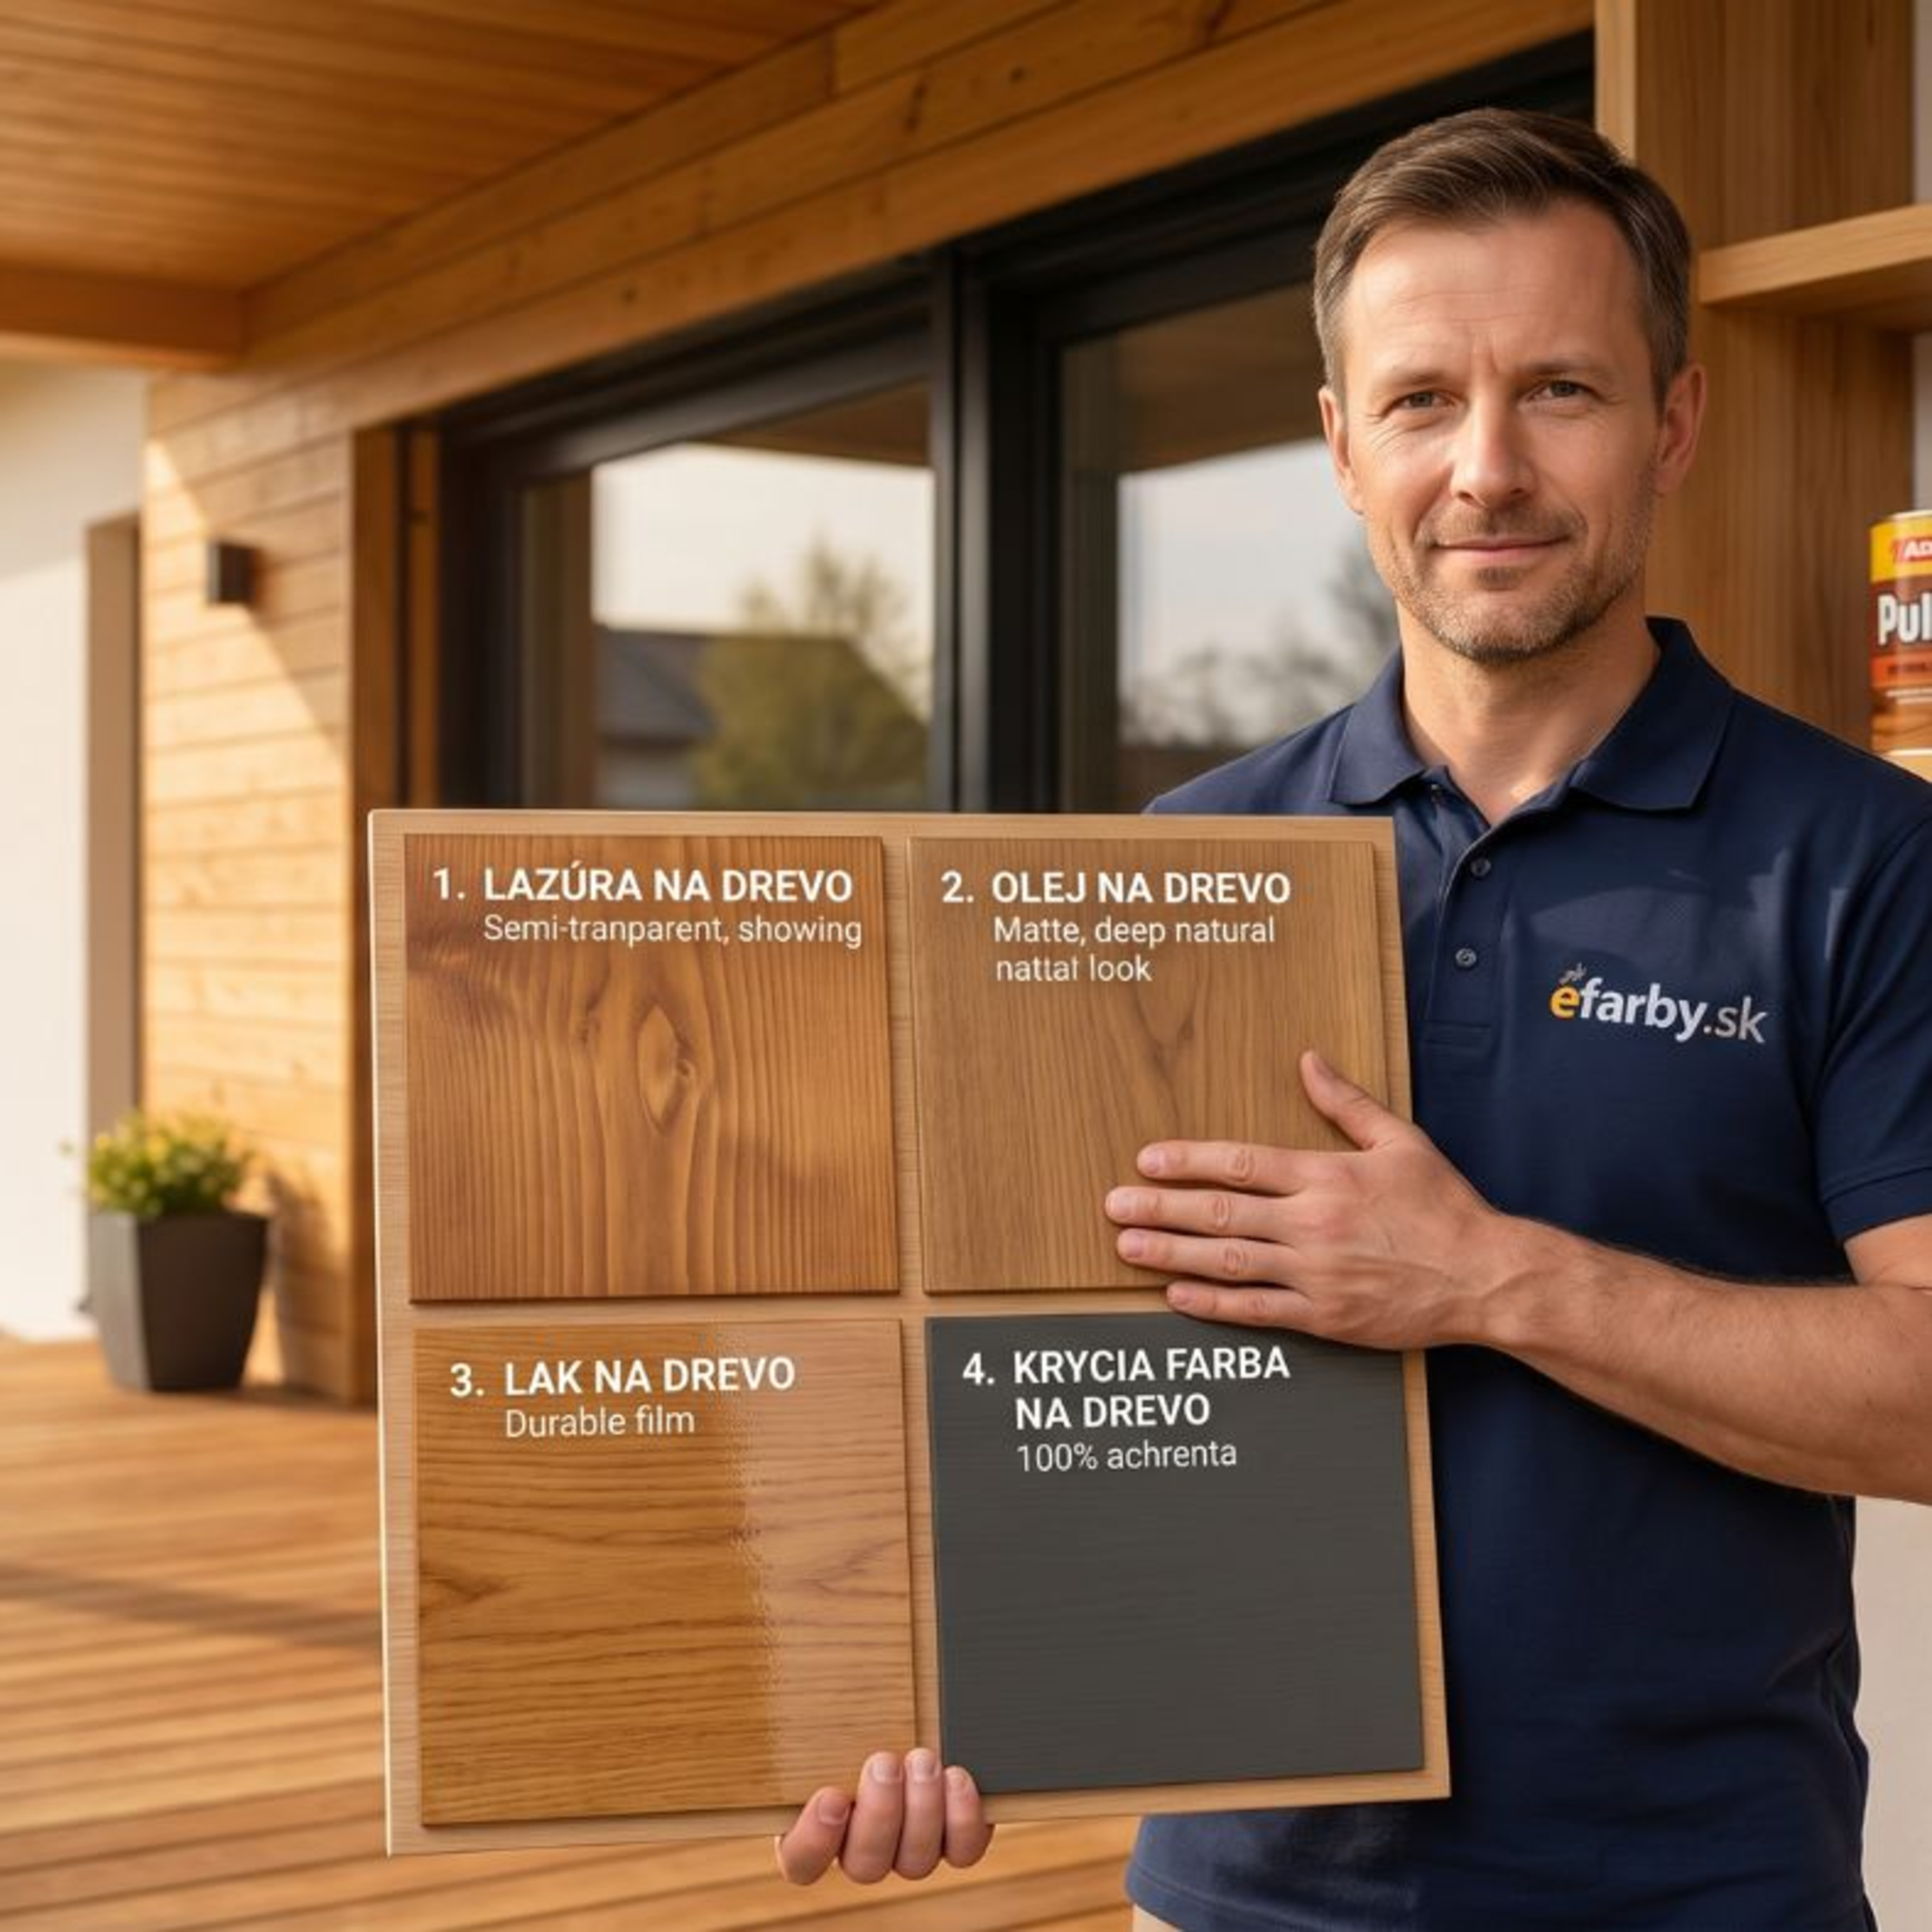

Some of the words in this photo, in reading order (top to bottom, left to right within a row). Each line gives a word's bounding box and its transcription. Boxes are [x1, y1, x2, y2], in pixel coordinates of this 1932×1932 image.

[433, 867, 465, 900] 1.
[484, 861, 643, 902] LAZÚRA
[654, 869, 710, 902] NA
[721, 869, 853, 903] DREVO
[940, 870, 974, 903] 2.
[992, 871, 1086, 903] OLEJ
[1097, 872, 1153, 903] NA
[1164, 872, 1292, 904] DREVO
[484, 914, 729, 947] Semi-tranparent,
[737, 914, 862, 949] showing
[994, 916, 1087, 947] Matte,
[1095, 916, 1166, 949] deep
[1175, 916, 1276, 943] natural
[1090, 953, 1152, 982] look
[1549, 976, 1768, 1043] efarby.sk
[450, 1363, 484, 1397] 3.
[505, 1361, 583, 1396] LAK
[594, 1359, 652, 1394] NA
[663, 1357, 796, 1392] DREVO
[963, 1352, 996, 1385] 4.
[1014, 1349, 1155, 1384] KRYCIA
[1166, 1346, 1291, 1381] FARBA
[506, 1407, 627, 1438] Durable
[636, 1405, 696, 1435] film
[1016, 1396, 1072, 1430] NA
[1084, 1393, 1211, 1428] DREVO
[1018, 1443, 1098, 1472] 100%
[1106, 1439, 1237, 1469] achrenta
